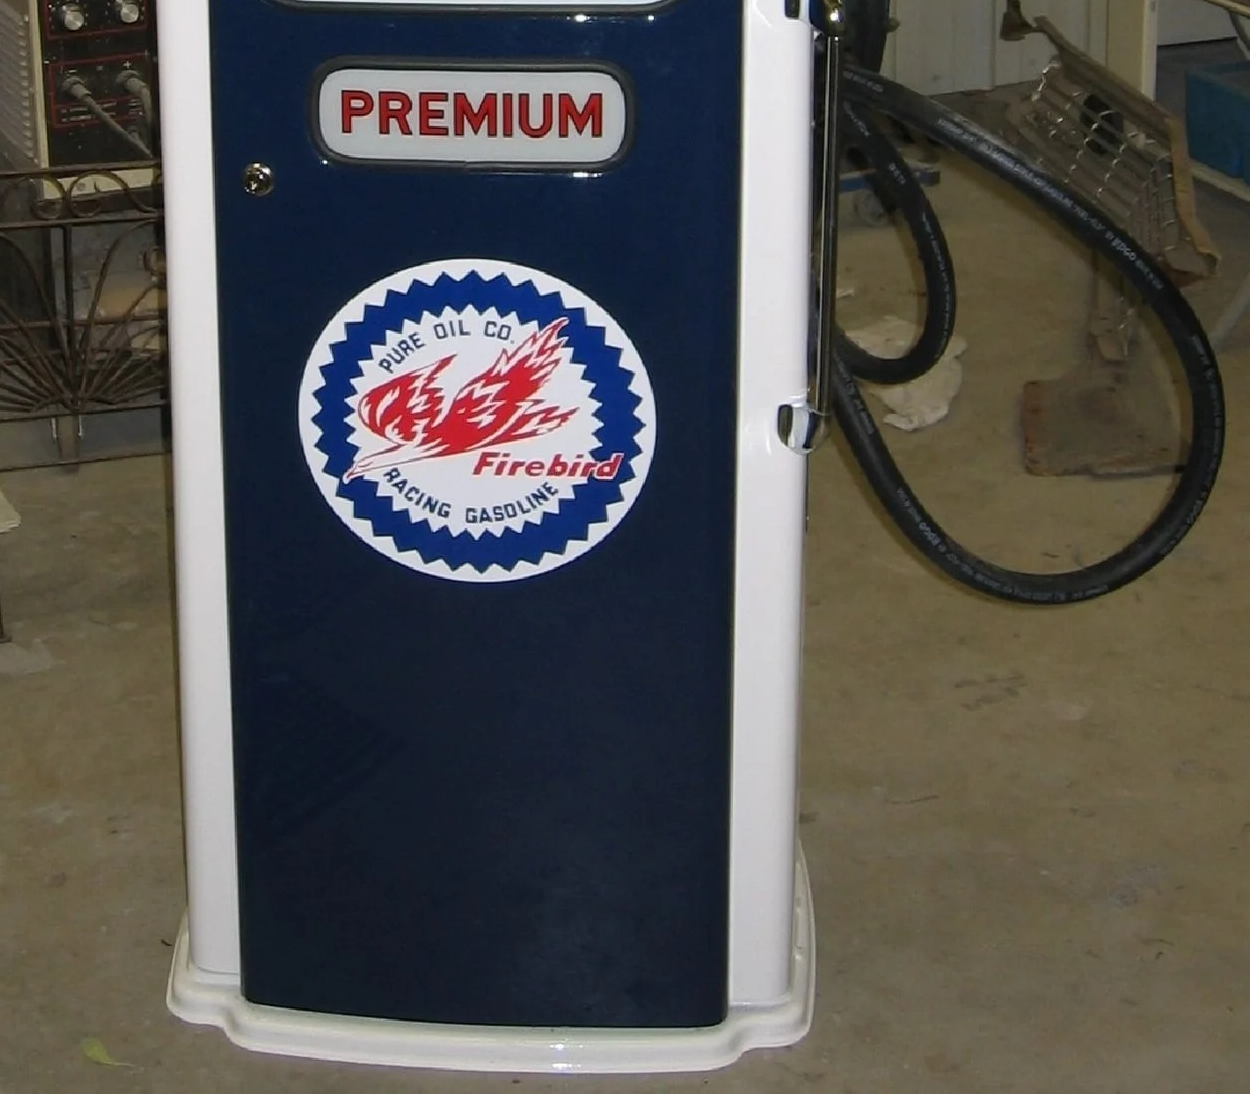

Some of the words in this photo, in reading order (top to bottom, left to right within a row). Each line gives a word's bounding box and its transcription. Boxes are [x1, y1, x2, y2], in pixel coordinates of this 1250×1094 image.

[340, 89, 603, 139] PREMIUM
[378, 331, 427, 374] PURE
[433, 319, 471, 340] OIL
[484, 320, 515, 344] CO.
[472, 452, 625, 479] Firebird
[383, 467, 452, 518] RACING
[465, 482, 559, 524] GASOLINE
